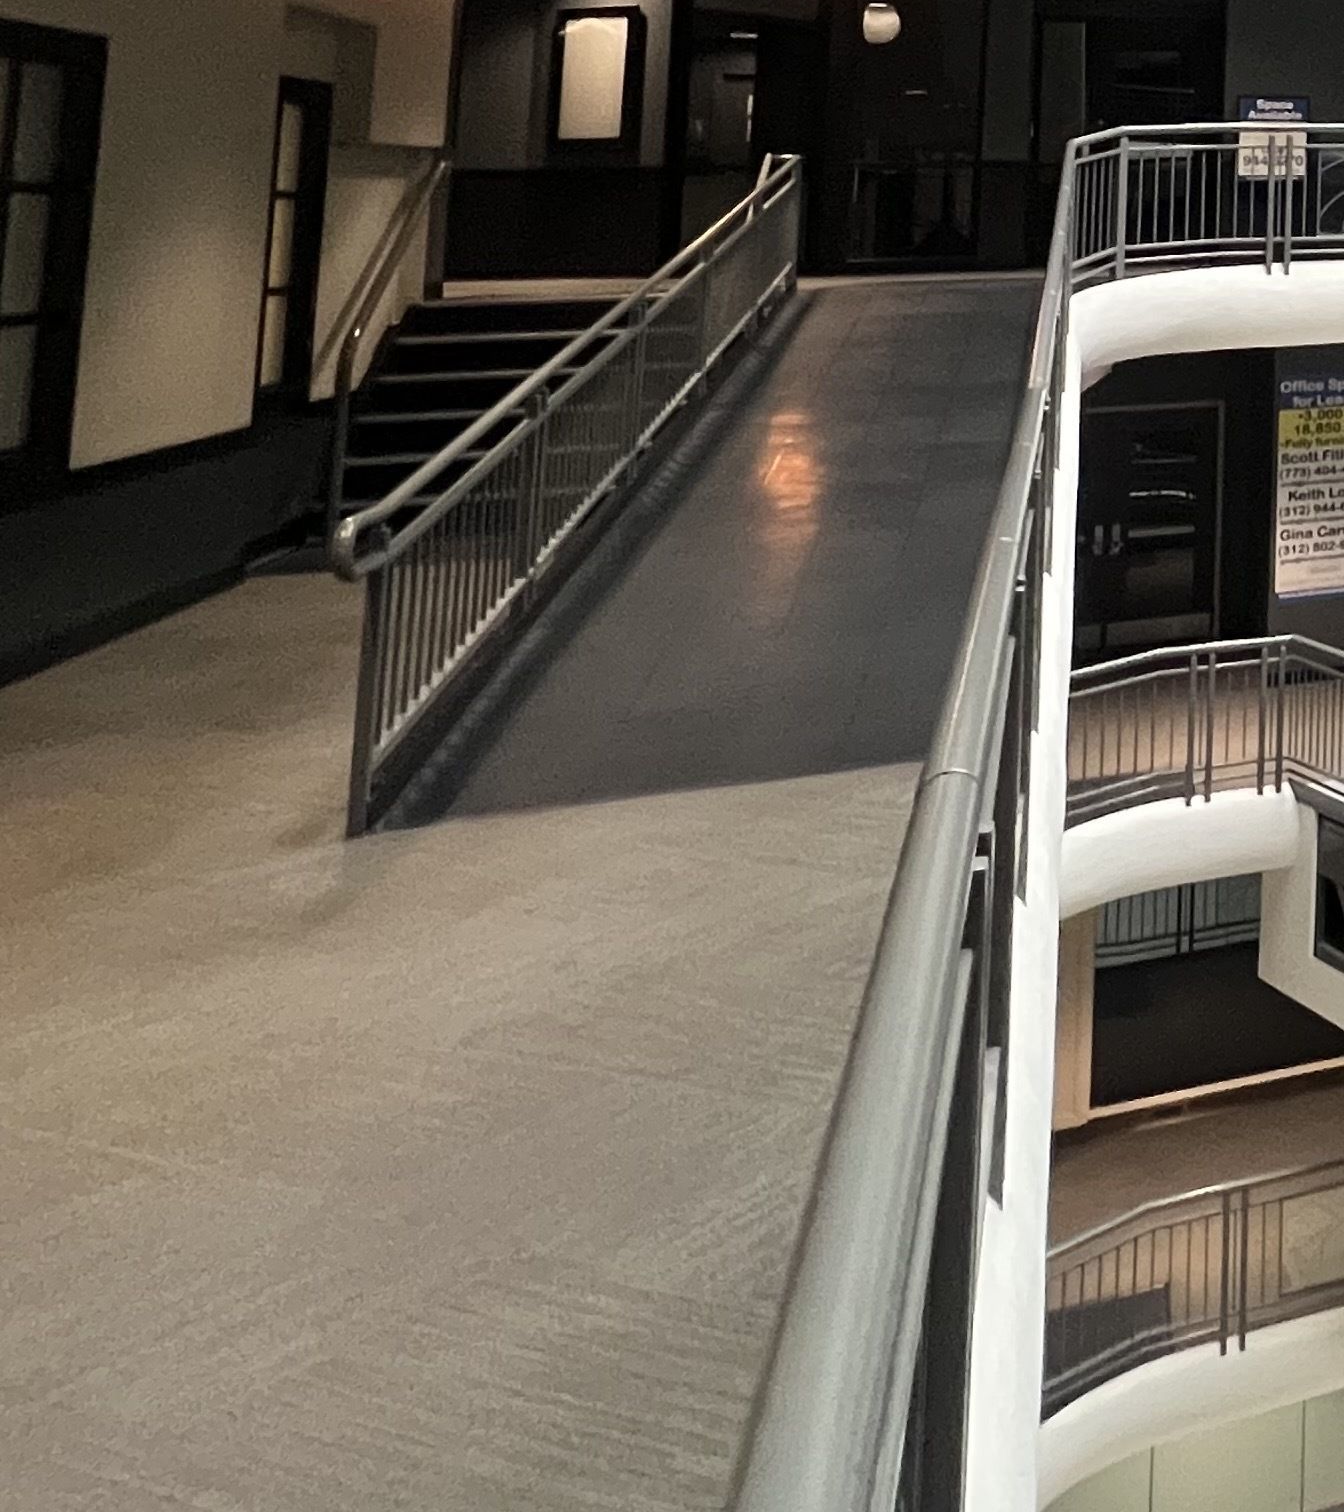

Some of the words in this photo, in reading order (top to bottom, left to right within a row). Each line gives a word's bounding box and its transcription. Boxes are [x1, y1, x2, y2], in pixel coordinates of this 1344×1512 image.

[1280, 380, 1325, 393] Office
[1281, 451, 1319, 465] Scott
[1288, 488, 1325, 502] Keith
[1279, 504, 1310, 518] (312)
[1280, 529, 1313, 541] Gina
[1278, 543, 1310, 558] (312)
